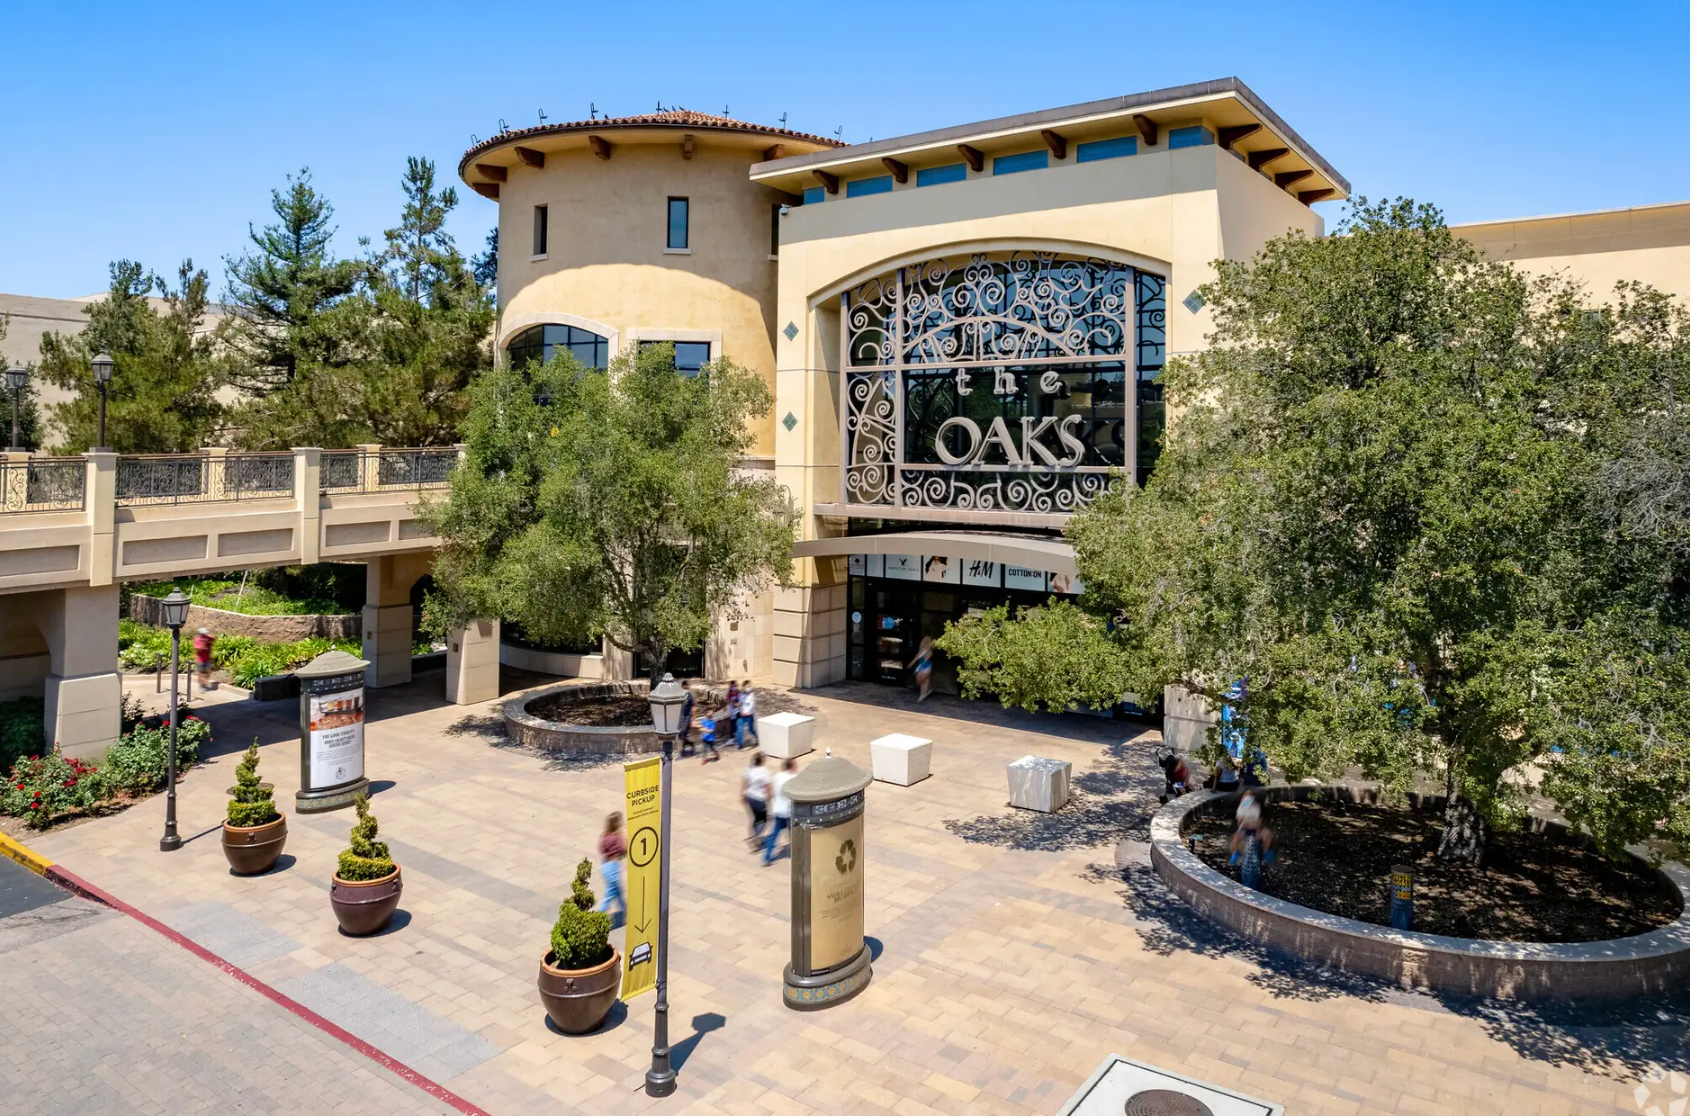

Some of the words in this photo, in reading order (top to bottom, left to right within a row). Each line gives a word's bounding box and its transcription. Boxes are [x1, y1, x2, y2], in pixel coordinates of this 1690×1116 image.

[955, 367, 1063, 396] the
[935, 414, 1086, 468] OAKS
[969, 560, 994, 579] H&M
[626, 785, 660, 799] CURBSIDE
[631, 795, 655, 806] PICKUP
[640, 837, 647, 856] 1
